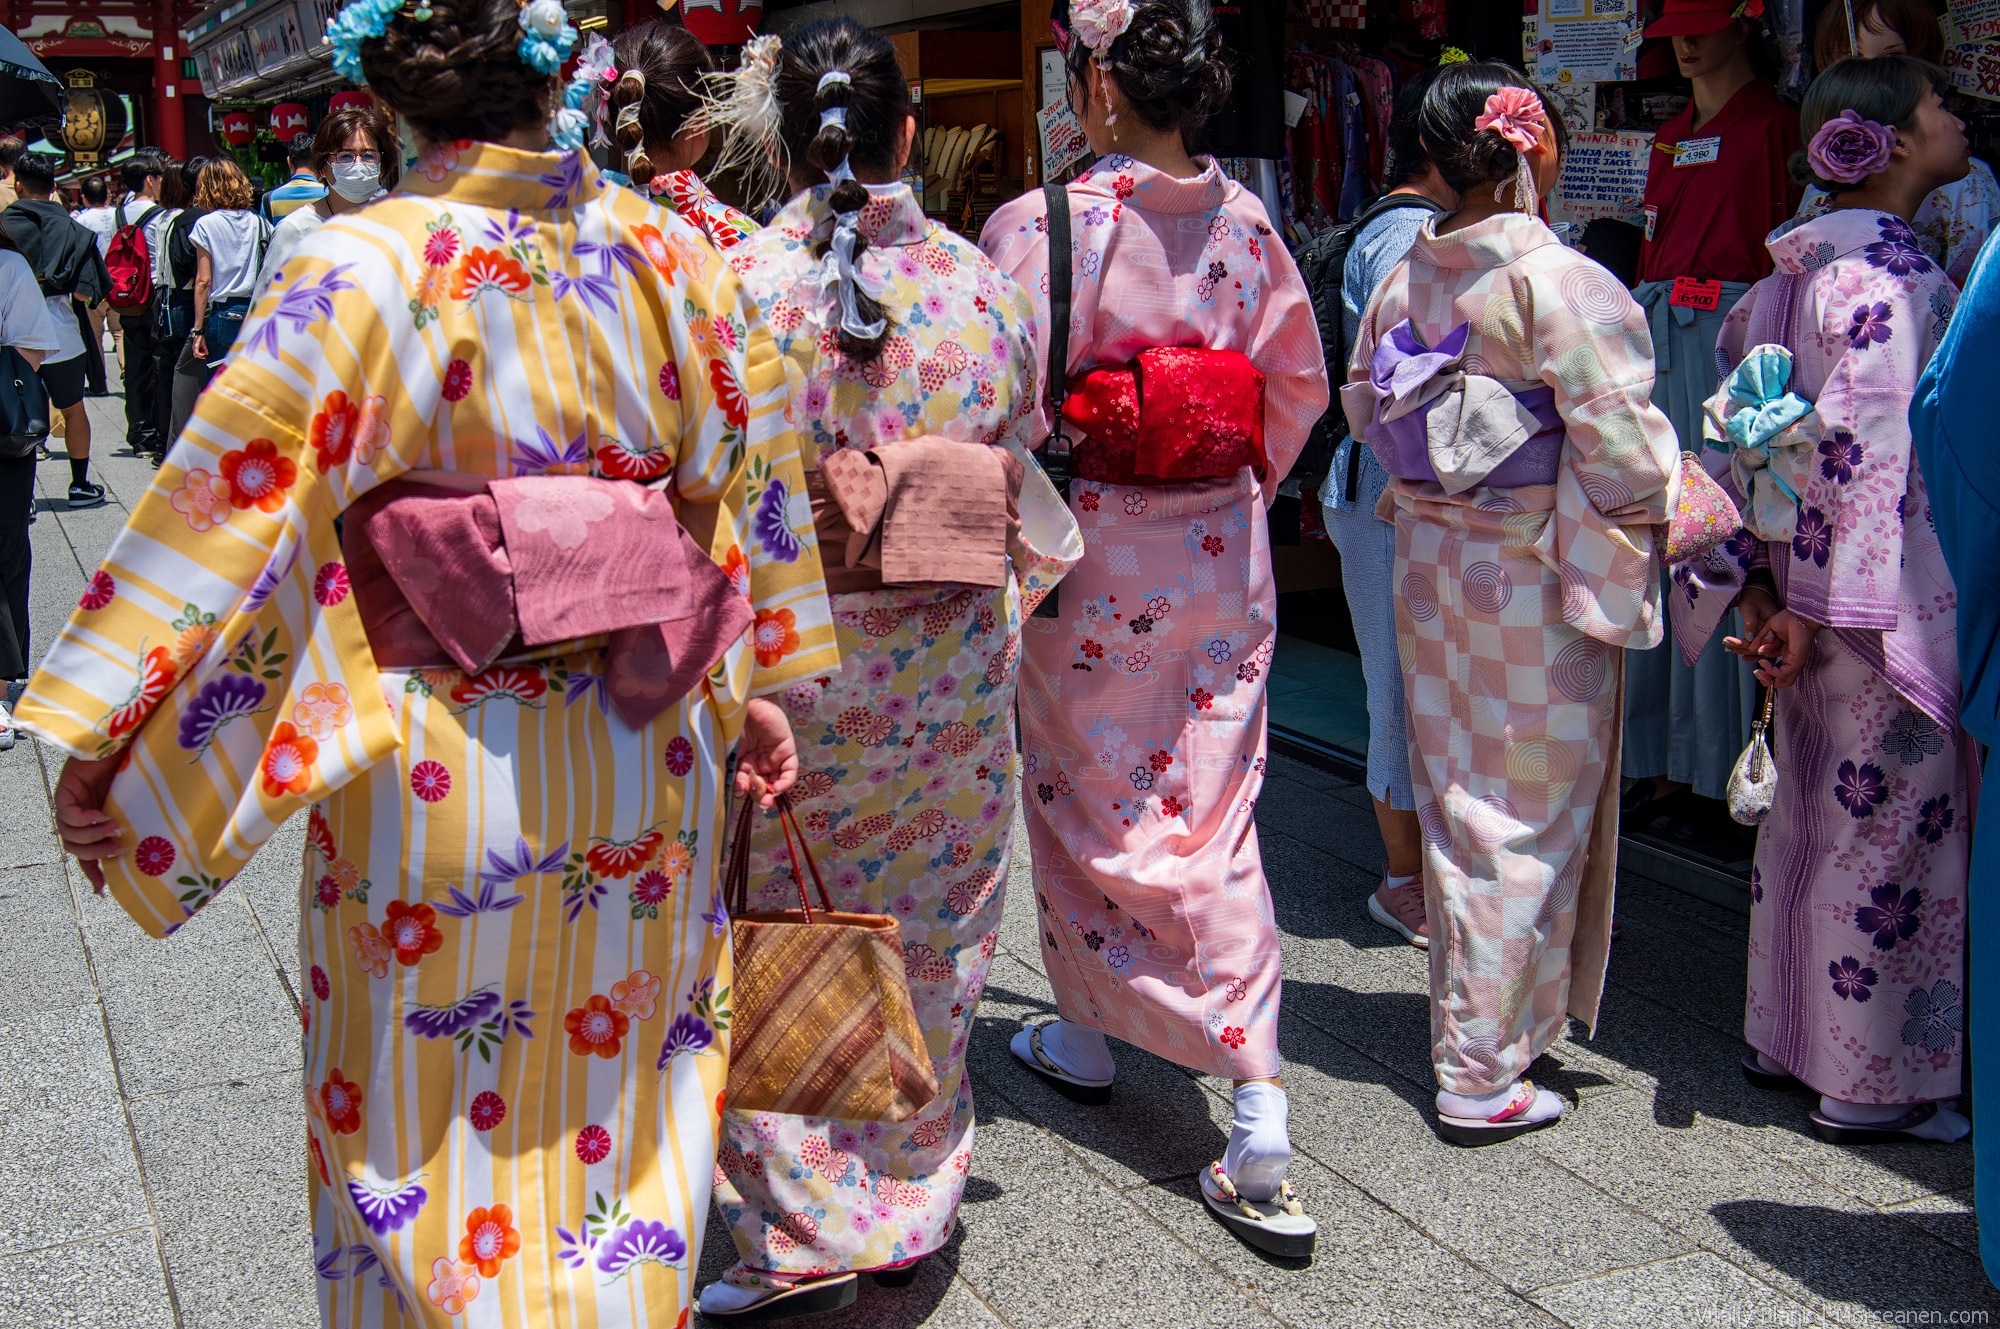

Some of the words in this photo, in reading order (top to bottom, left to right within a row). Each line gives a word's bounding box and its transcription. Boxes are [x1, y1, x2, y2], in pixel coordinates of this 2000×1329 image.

[1943, 49, 1974, 70] BIG
[1976, 56, 2000, 75] SIZ
[1044, 98, 1063, 119] SPECIAL
[1044, 116, 1056, 132] LADY'S
[1577, 134, 1618, 144] NINJA
[1620, 138, 1641, 147] SET
[1686, 150, 1709, 160] 4.980
[1565, 166, 1597, 174] PANTS
[1617, 168, 1648, 177] STRING
[1591, 185, 1633, 193] PROTECTOR
[1597, 193, 1620, 202] BELT
